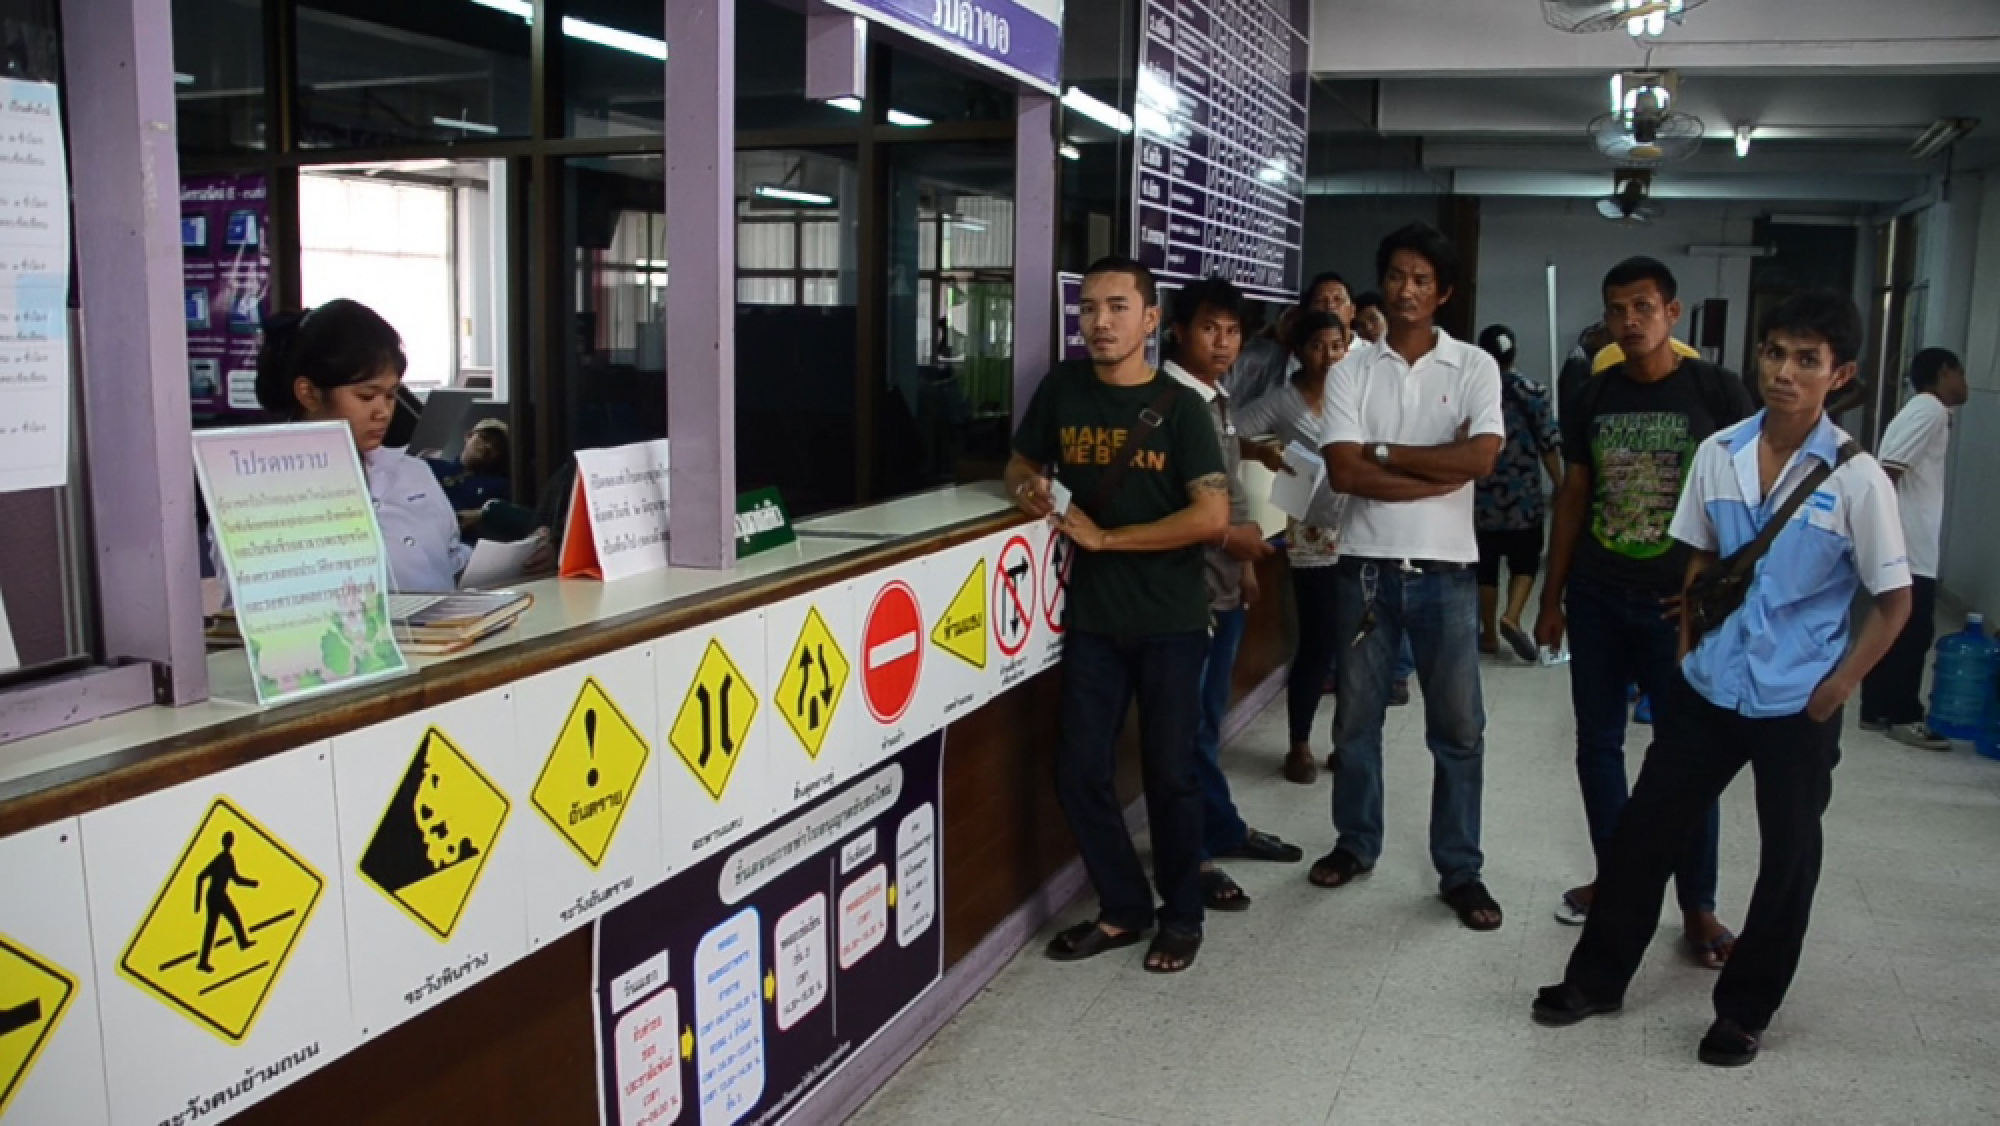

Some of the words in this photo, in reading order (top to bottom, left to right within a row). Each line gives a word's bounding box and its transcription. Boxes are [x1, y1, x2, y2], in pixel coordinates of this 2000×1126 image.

[1060, 425, 1129, 448] MAKE
[229, 449, 329, 476] โปรดทราบ
[569, 789, 623, 826] อันตราย
[560, 875, 635, 922] ระวังอันตราย
[403, 951, 489, 1004] ระวังหินร่วง
